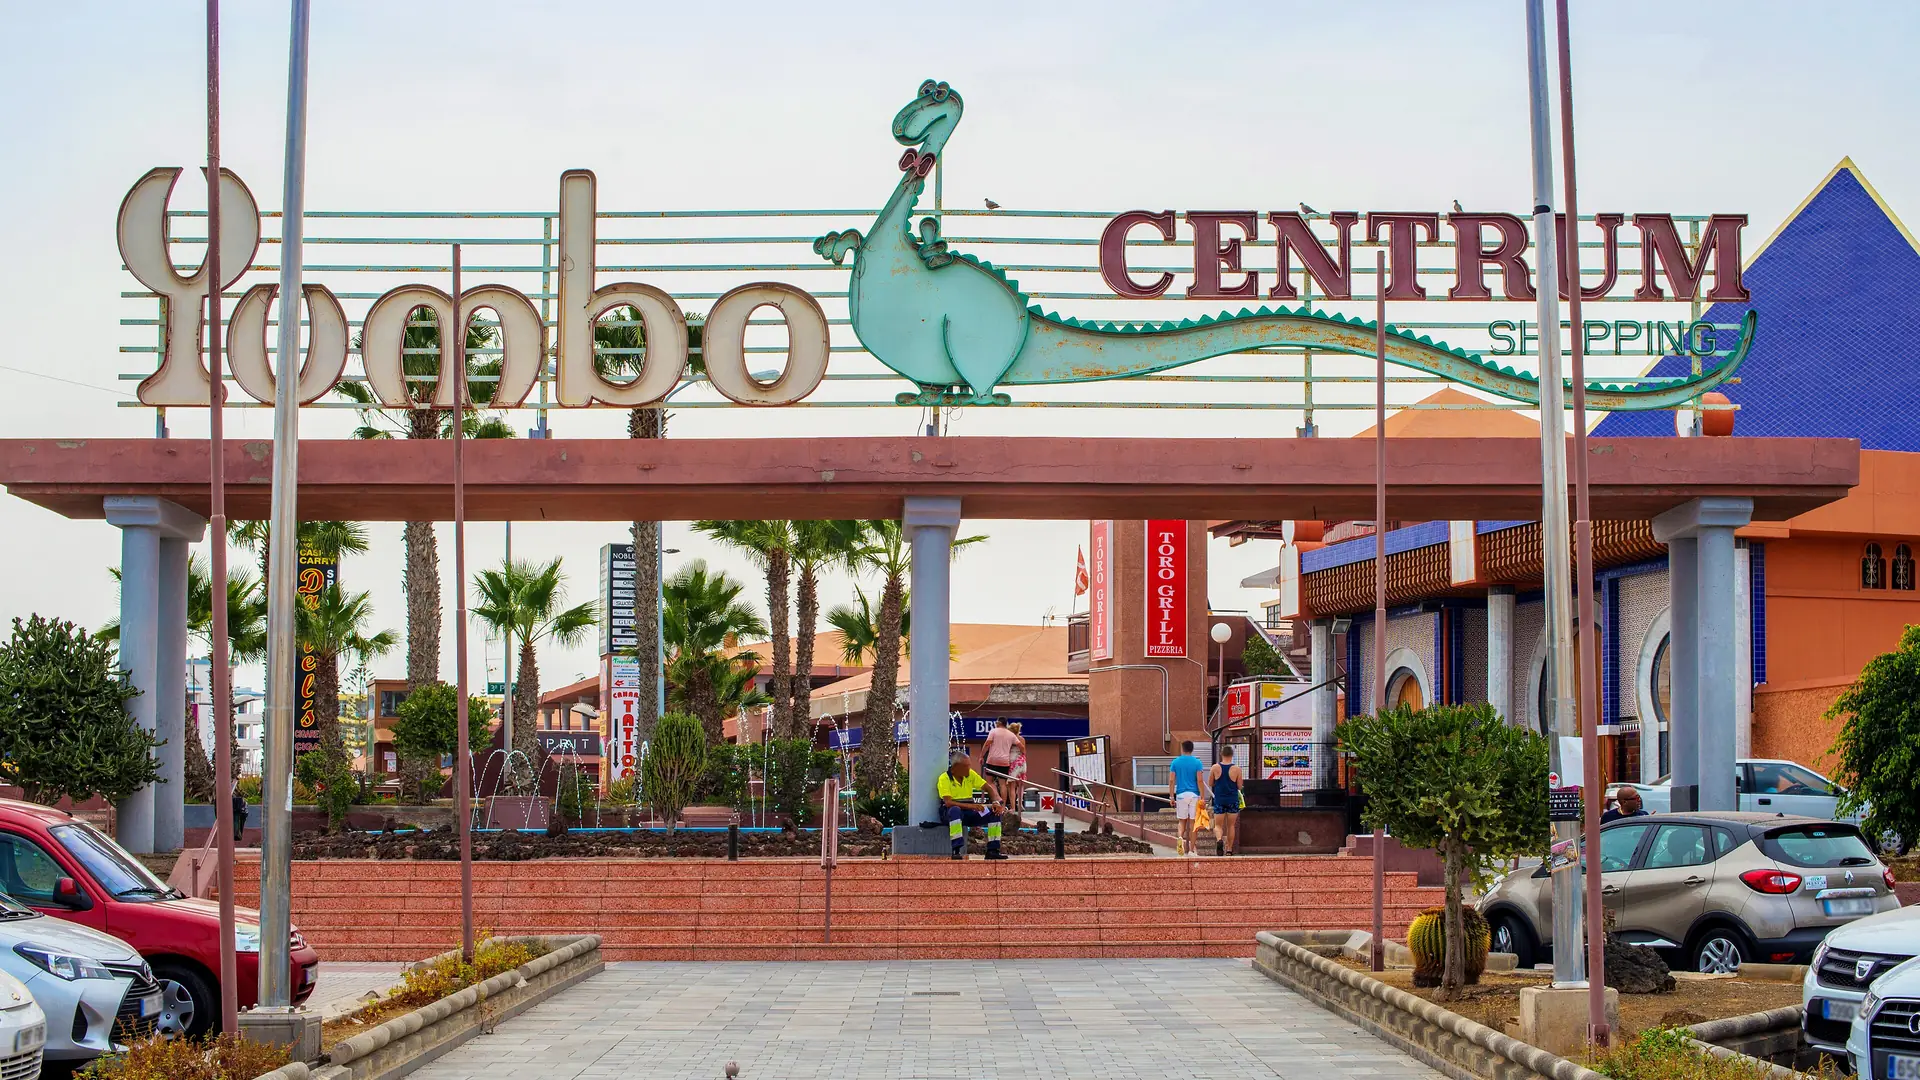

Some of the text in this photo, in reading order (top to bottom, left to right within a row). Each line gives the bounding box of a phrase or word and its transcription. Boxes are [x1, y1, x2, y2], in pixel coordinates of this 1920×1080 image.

[1099, 209, 1750, 301] CENTRUM
[117, 166, 831, 409] Yumbo
[1488, 320, 1717, 355] SHPPING
[299, 557, 336, 565] CARRY
[1096, 537, 1104, 584] TORO
[1157, 532, 1175, 645] TORO GRILL
[1096, 589, 1104, 649] GRILL
[1149, 646, 1184, 654] PIZZERIA
